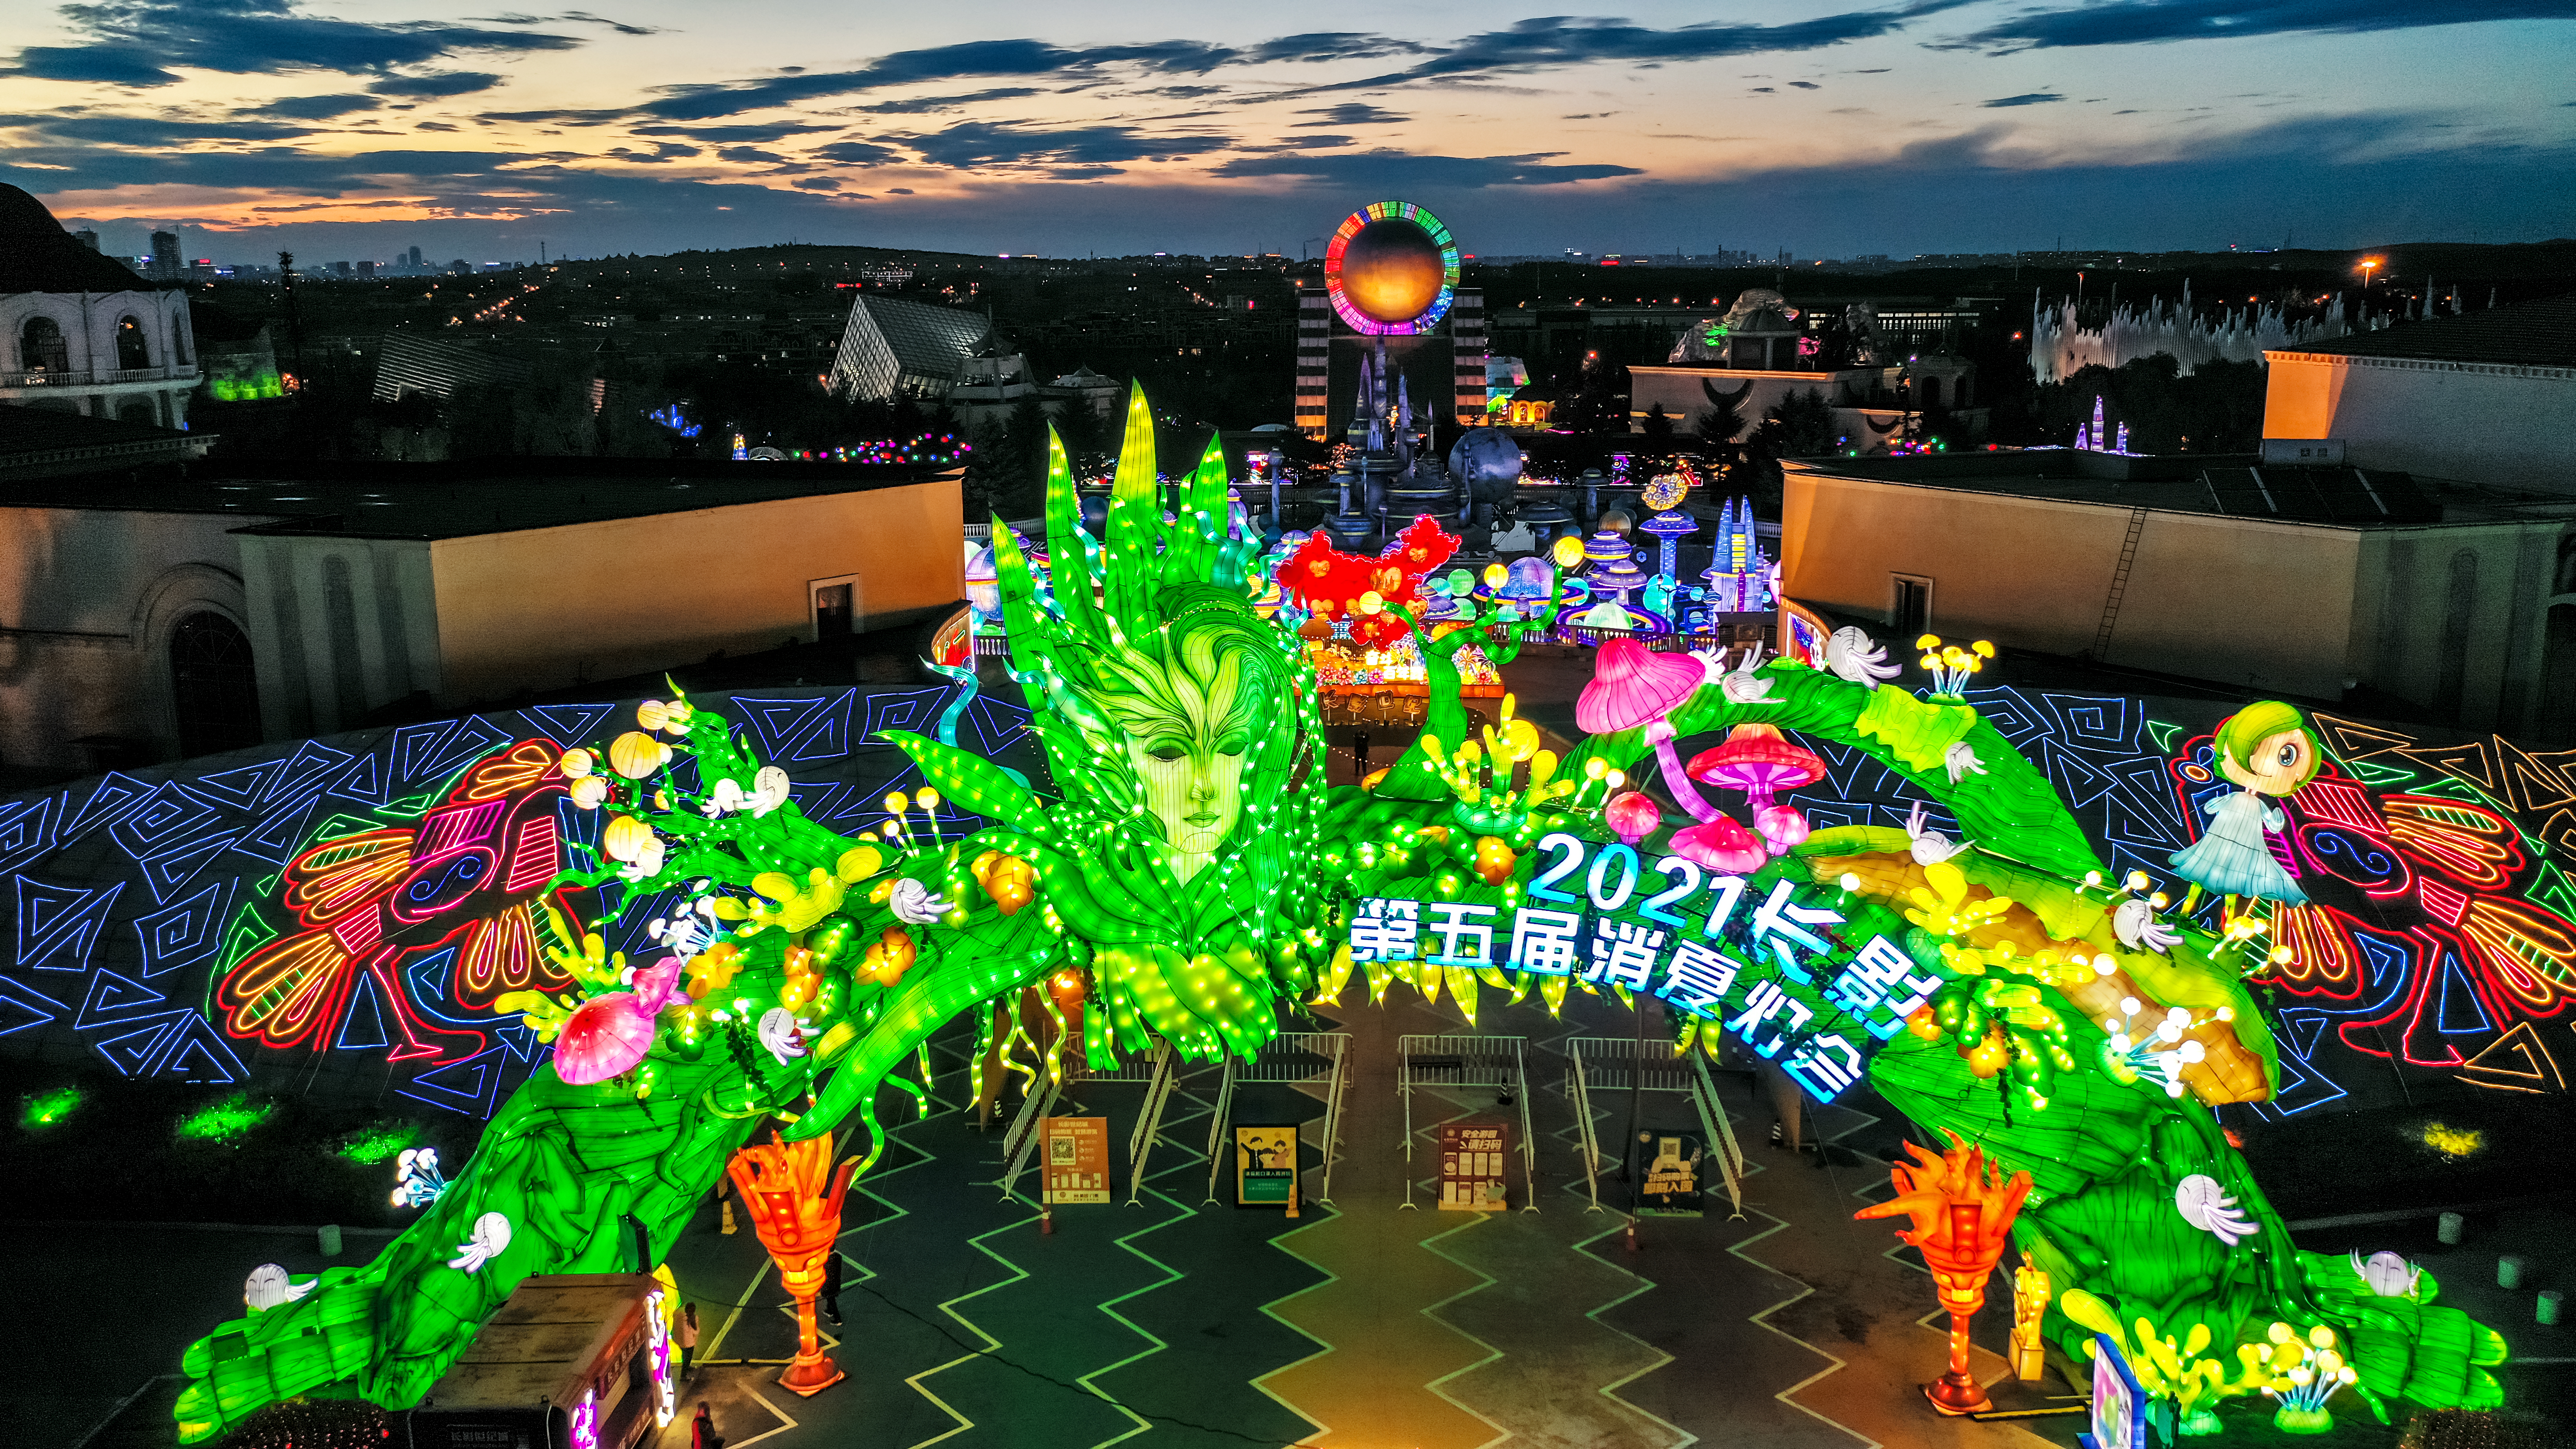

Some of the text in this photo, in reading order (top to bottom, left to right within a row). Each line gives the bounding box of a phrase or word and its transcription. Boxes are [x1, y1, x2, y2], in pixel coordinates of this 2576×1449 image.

[1350, 897, 1864, 1104] 第五届消夏灯会
[1467, 1139, 1503, 1150] 请扫码
